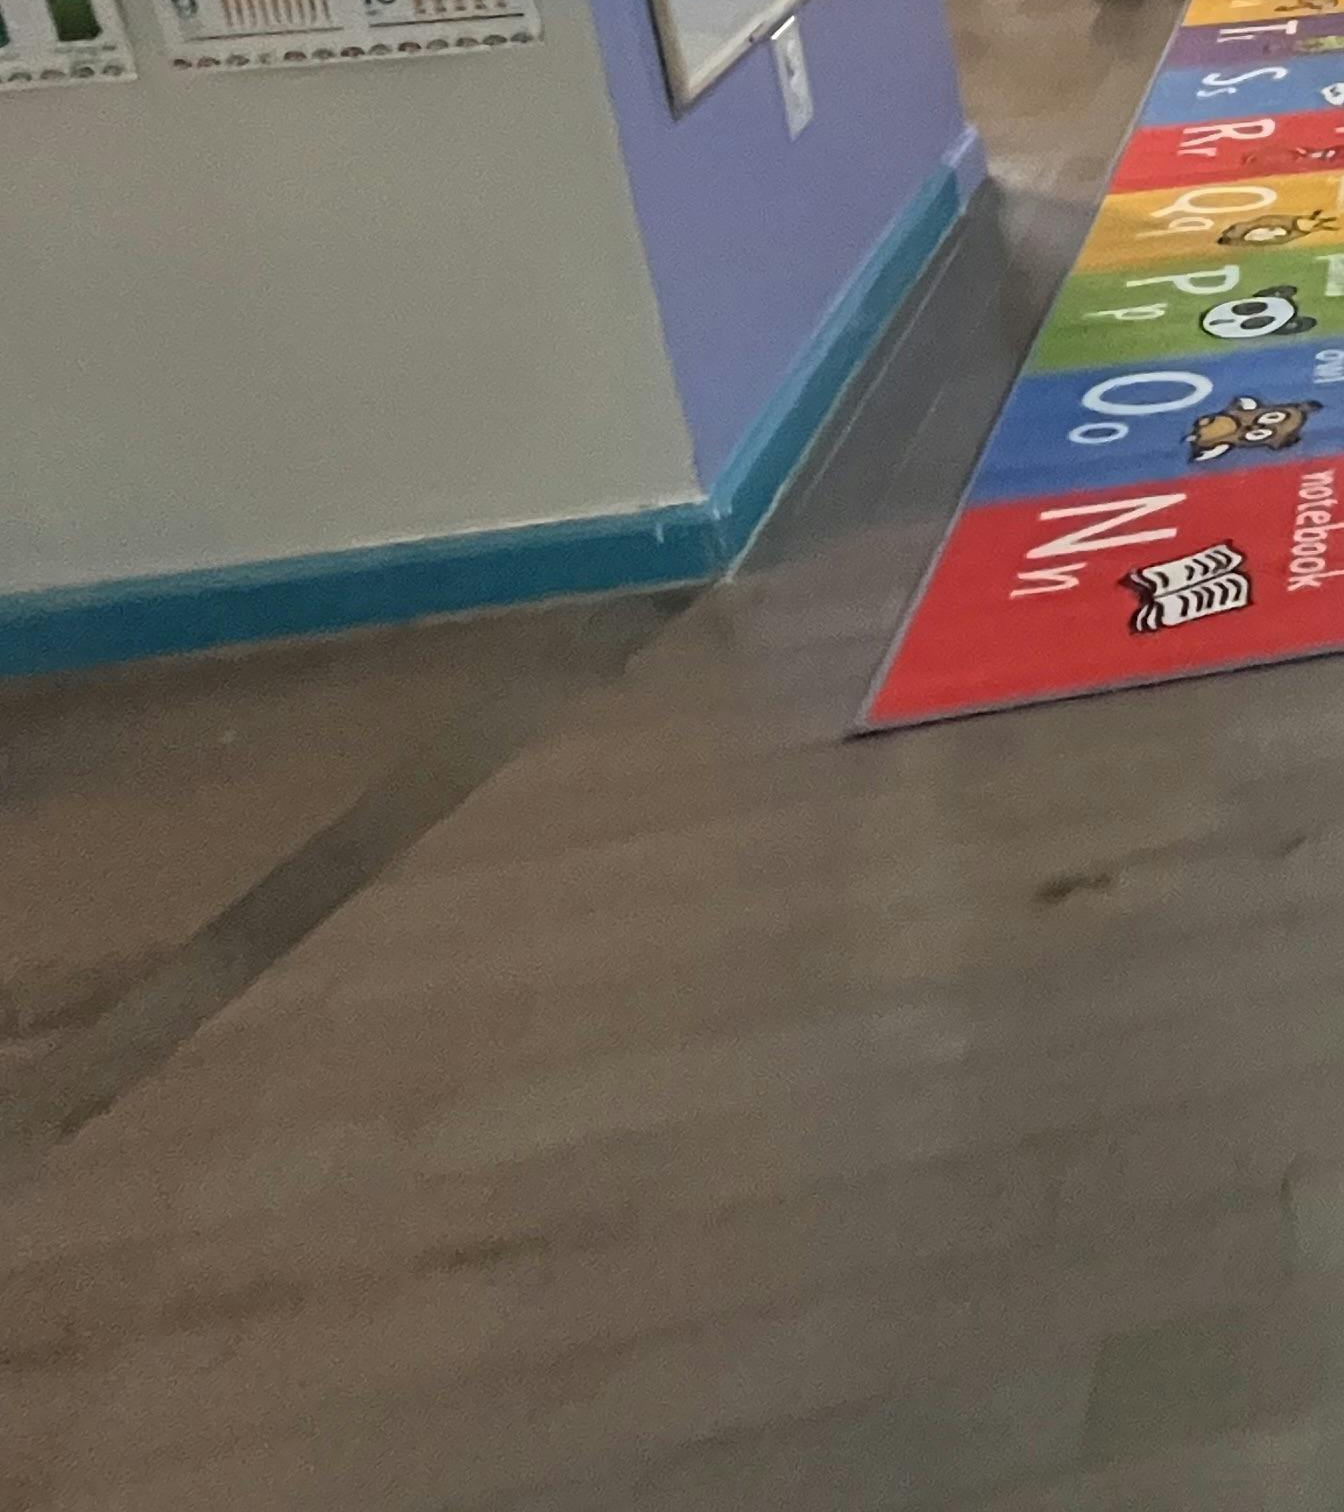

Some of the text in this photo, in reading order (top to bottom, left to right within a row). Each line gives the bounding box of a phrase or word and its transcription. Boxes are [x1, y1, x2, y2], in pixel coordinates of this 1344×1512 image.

[1196, 66, 1288, 98] Ss
[1177, 117, 1276, 158] Rr
[1137, 185, 1277, 238] Qq
[1083, 264, 1240, 321] Pp
[1068, 371, 1213, 444] Oo
[1008, 492, 1187, 599] Nn
